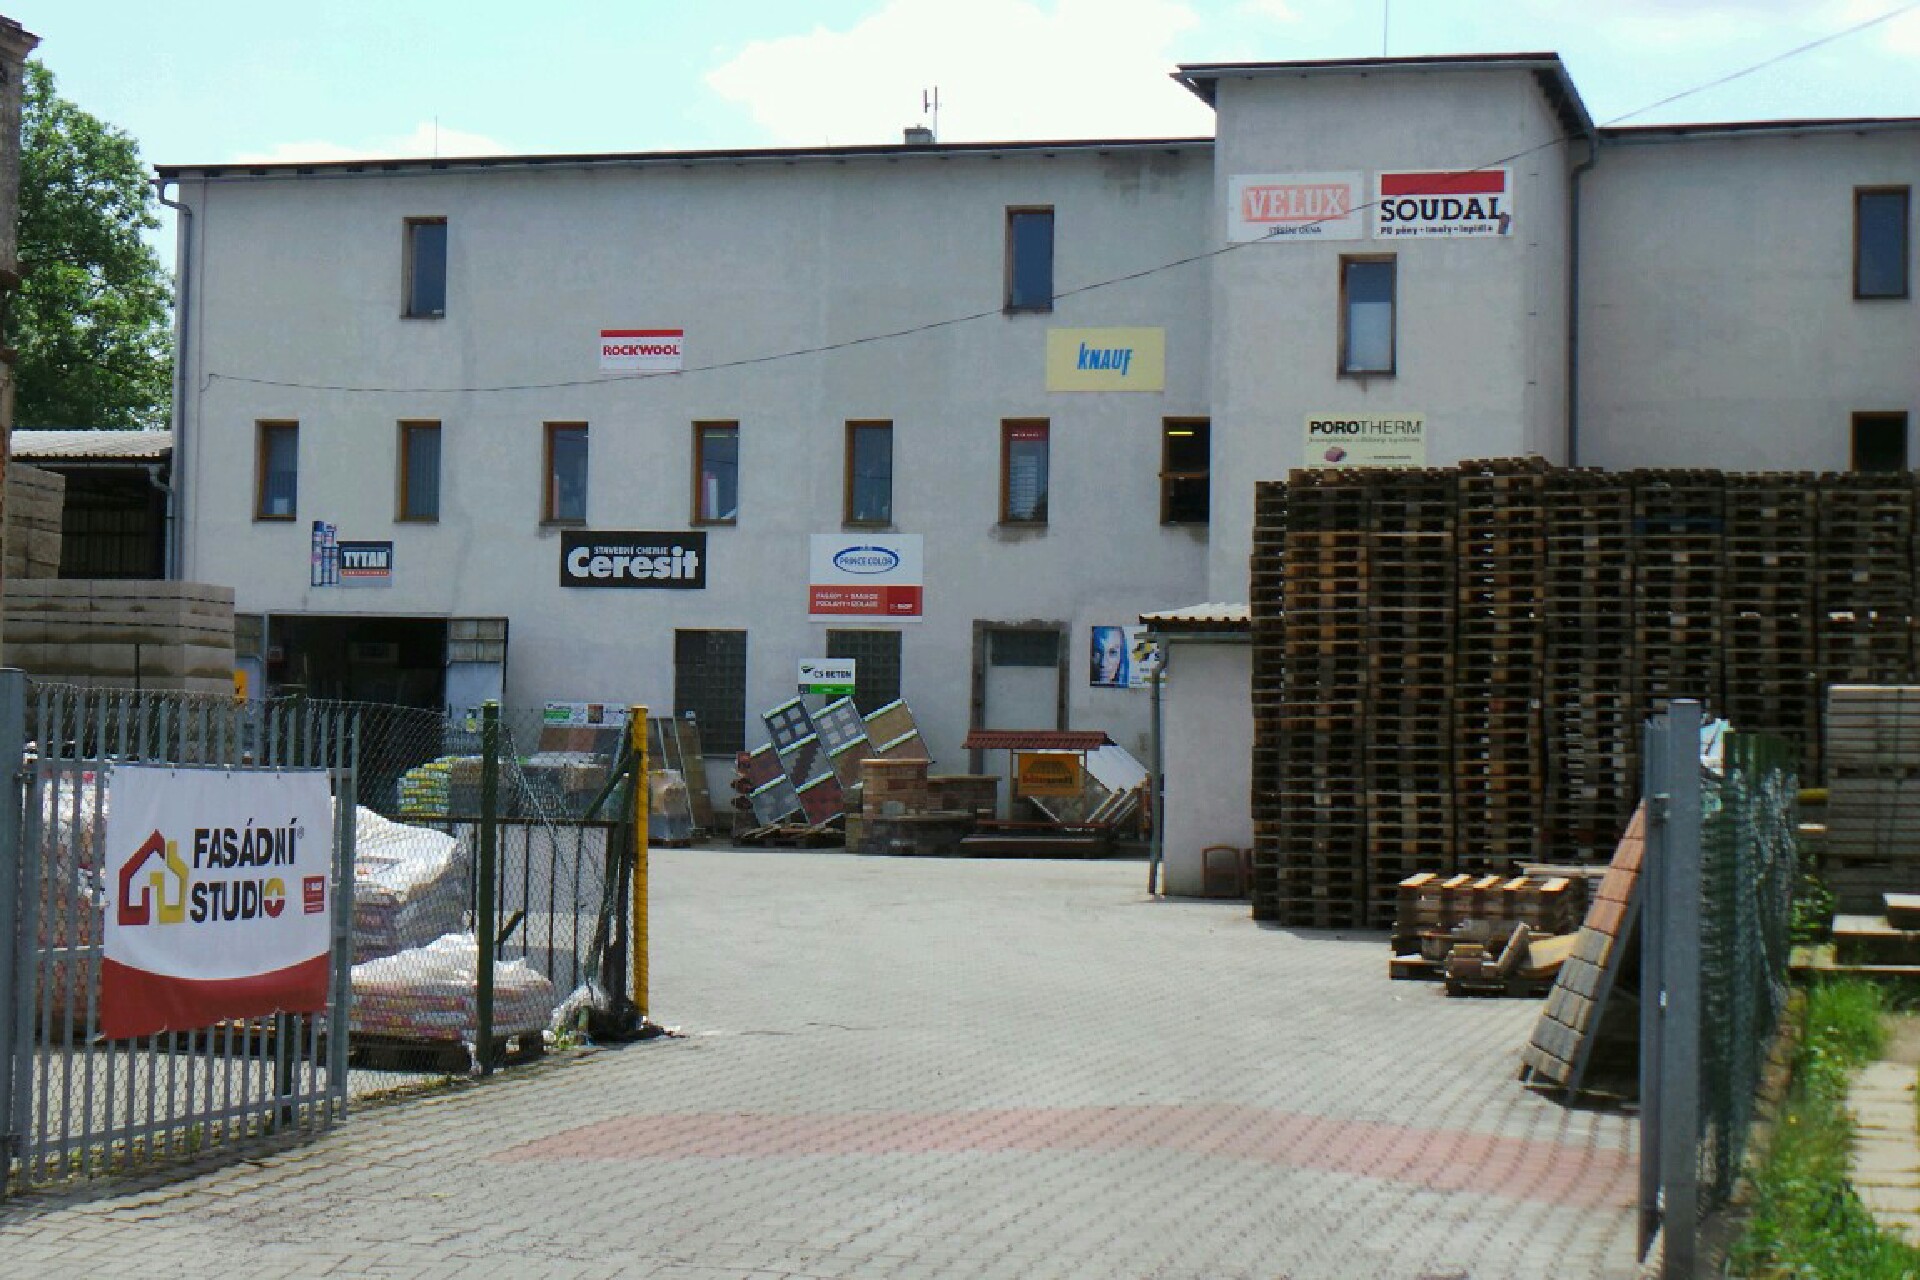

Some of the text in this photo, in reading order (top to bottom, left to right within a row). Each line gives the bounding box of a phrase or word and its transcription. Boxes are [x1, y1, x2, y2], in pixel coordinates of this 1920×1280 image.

[1247, 188, 1344, 216] VELUX
[1380, 197, 1502, 221] SOUDAL
[603, 345, 680, 355] ROCKWOOL
[1310, 421, 1422, 434] POROTHERM
[344, 551, 387, 567] TYTAN
[568, 546, 699, 579] Ceresit
[194, 817, 297, 868] FASÁDNÍ
[190, 878, 285, 923] STUDIO
